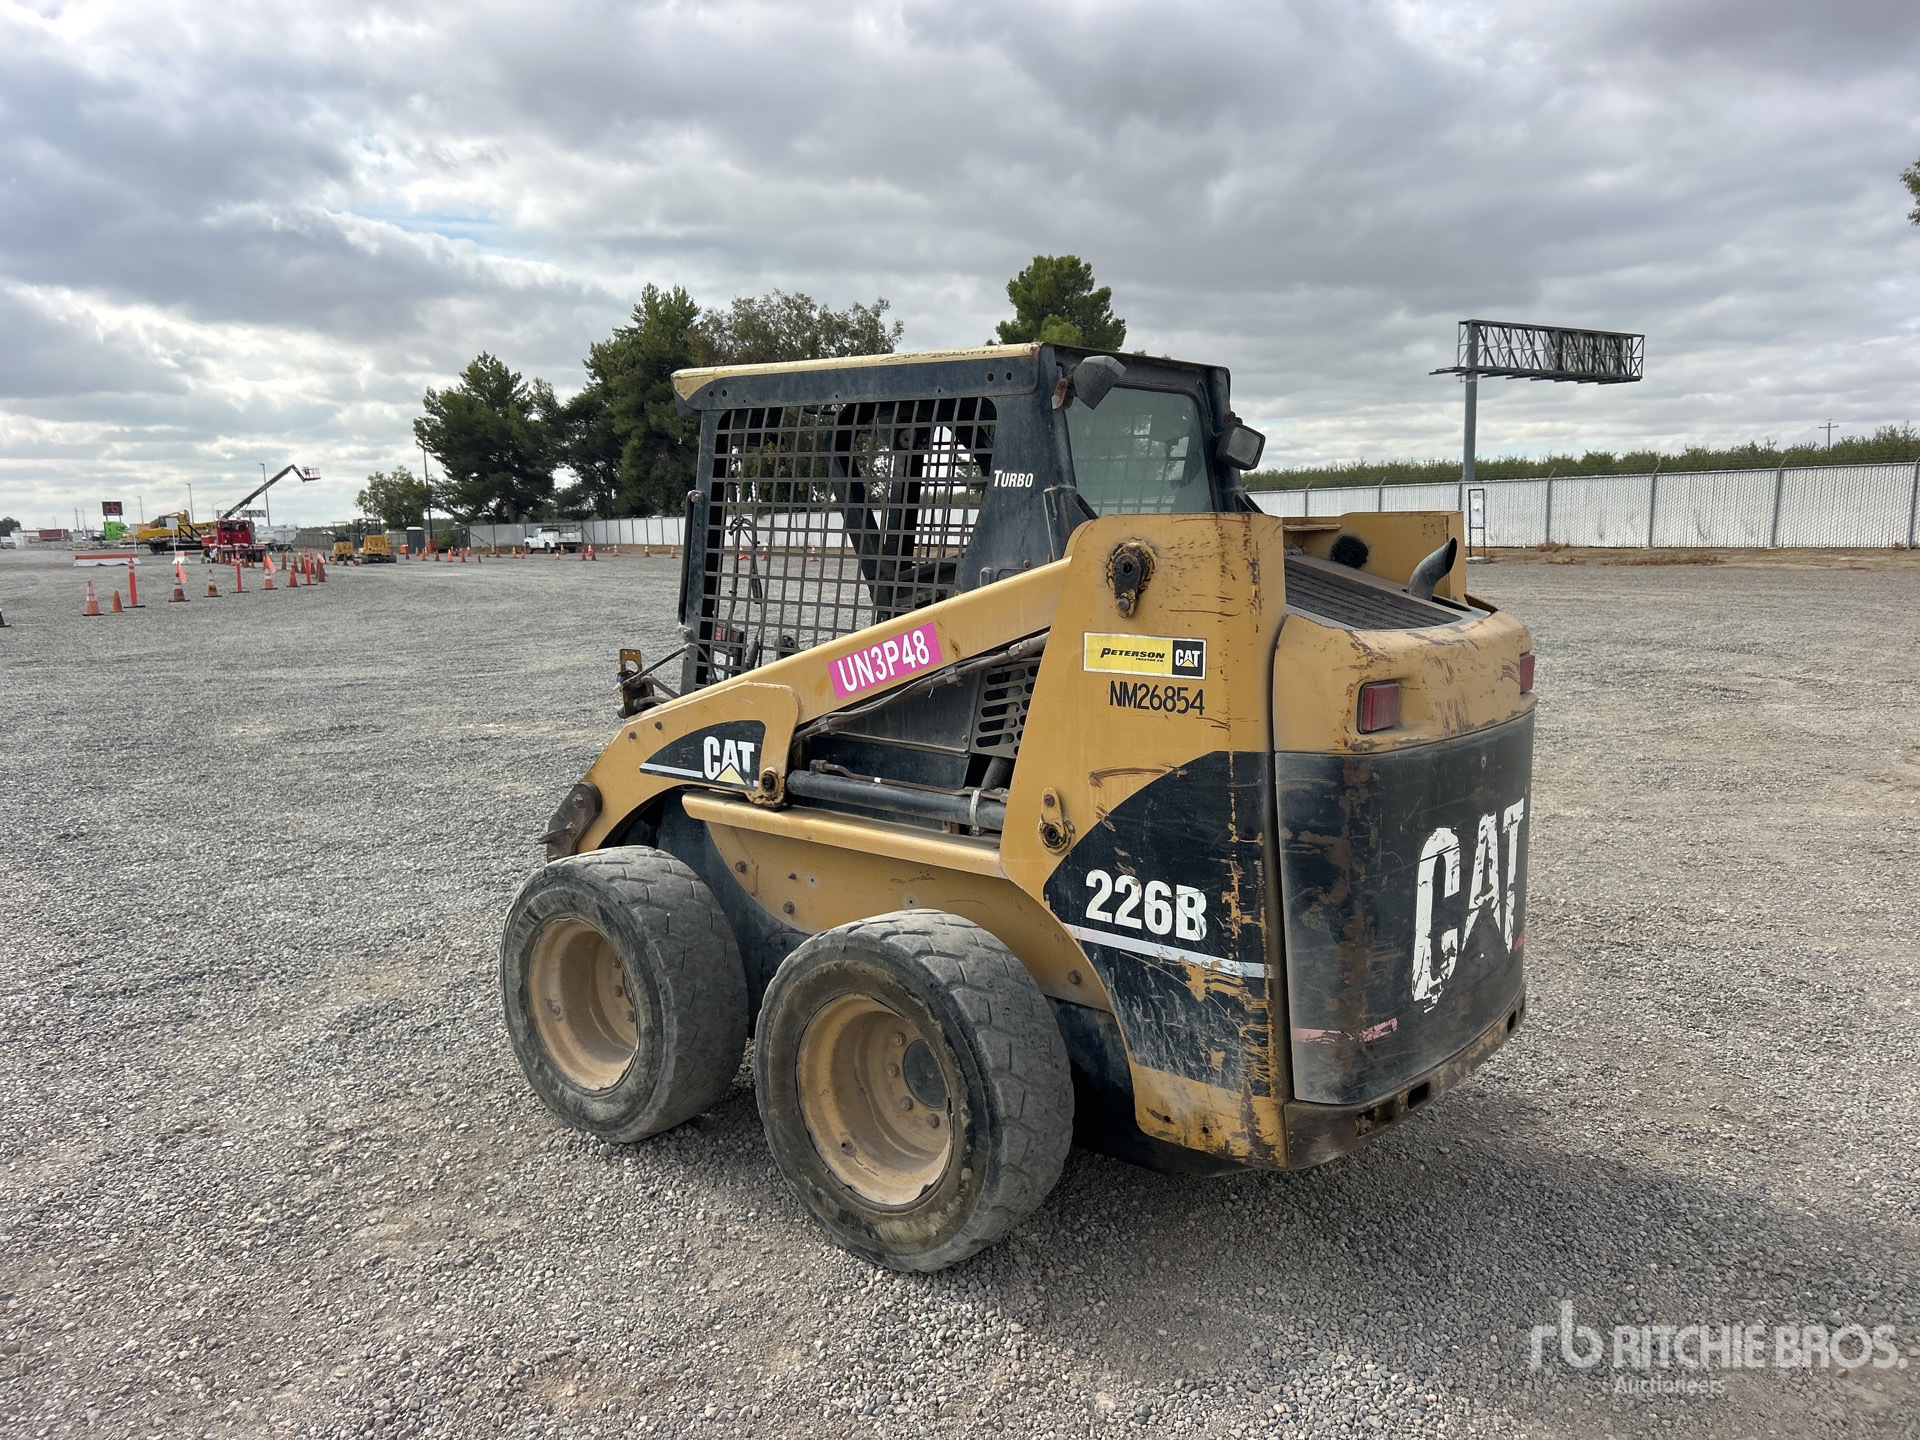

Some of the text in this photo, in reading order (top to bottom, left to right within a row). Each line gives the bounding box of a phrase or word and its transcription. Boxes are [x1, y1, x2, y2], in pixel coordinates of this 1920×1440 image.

[837, 630, 930, 692] UN3P48
[1175, 649, 1201, 668] CAT
[1109, 680, 1205, 715] NM26854
[703, 736, 755, 780] CAT
[1085, 869, 1207, 941] 226B
[1411, 798, 1525, 1014] CAT
